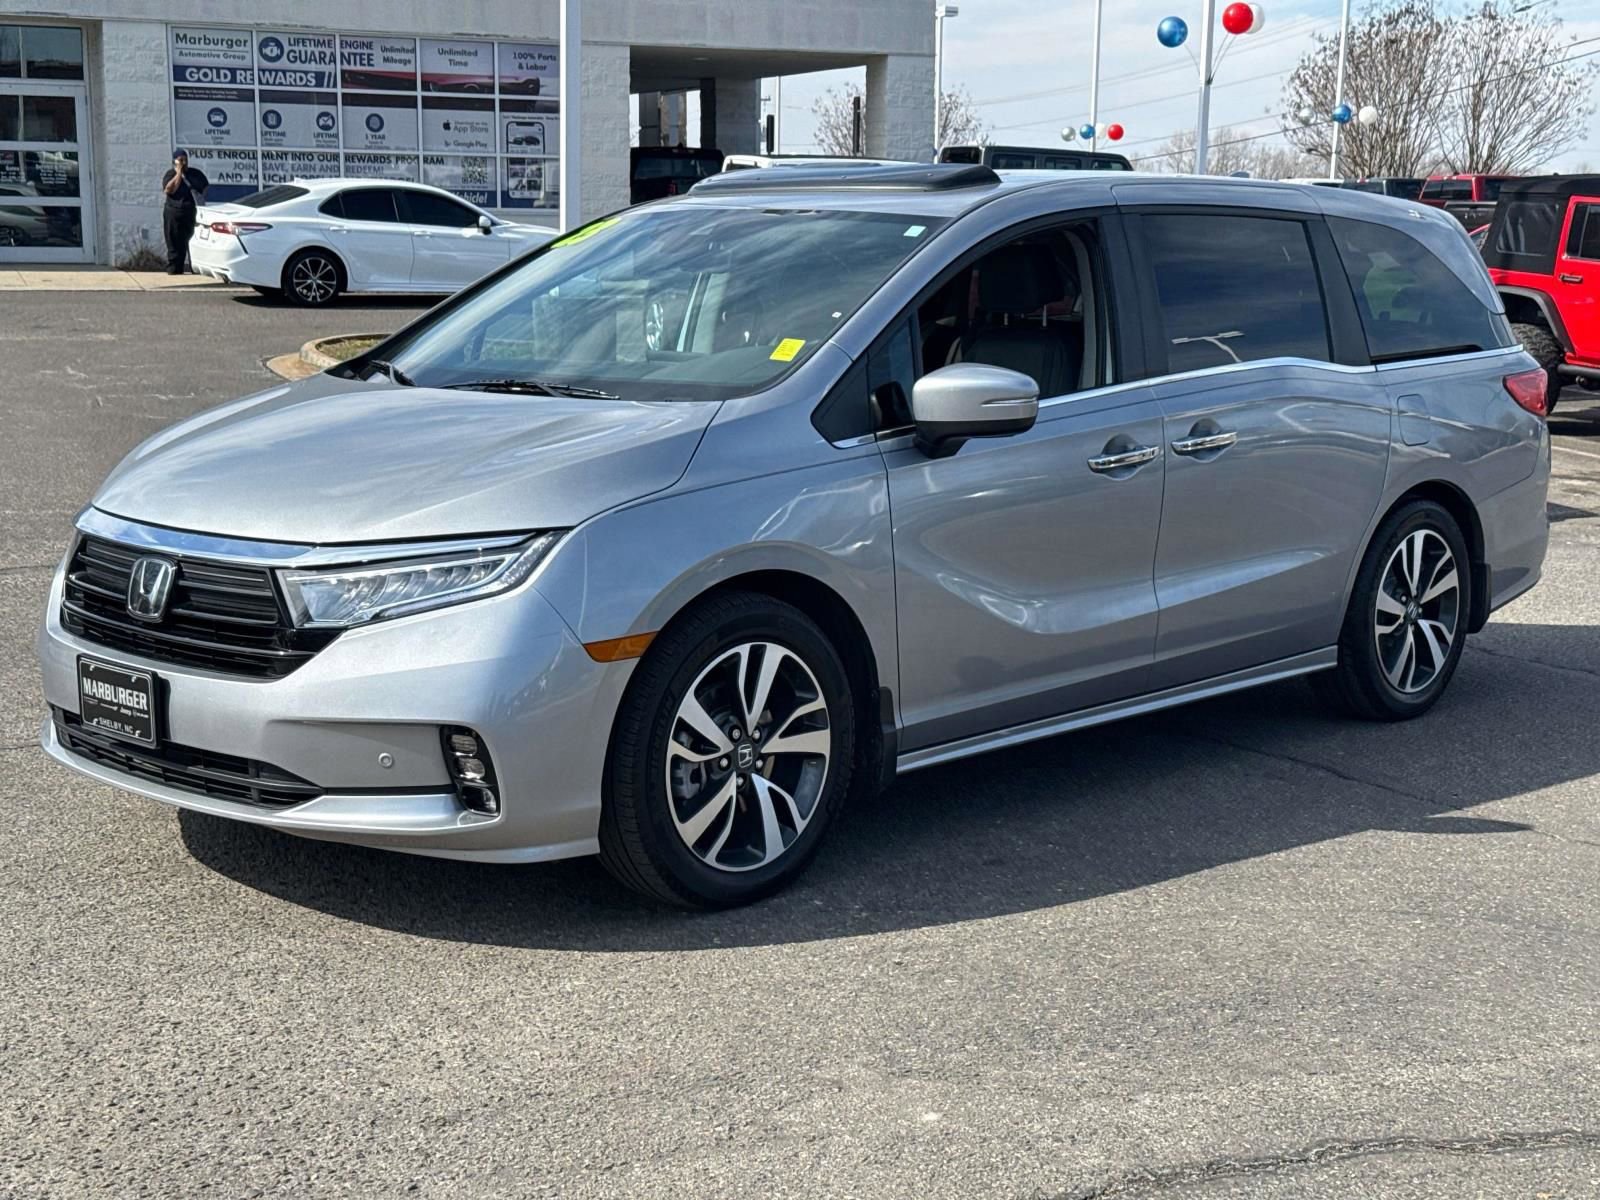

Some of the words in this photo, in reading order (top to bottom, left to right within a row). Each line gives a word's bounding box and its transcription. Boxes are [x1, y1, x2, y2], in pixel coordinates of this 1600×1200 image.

[175, 33, 248, 48] Marburger
[288, 37, 333, 48] LIFETIME
[340, 40, 374, 50] ENGINE
[380, 45, 415, 54] Unlimited
[437, 48, 478, 57] Unlimited
[178, 50, 221, 60] Automotive
[223, 52, 246, 62] Group
[286, 50, 374, 67] GUARANTEE
[382, 56, 412, 66] Mileage
[512, 52, 536, 60] 100%
[538, 52, 557, 61] Parts
[448, 58, 468, 67] Time
[526, 62, 548, 71] Labor
[186, 68, 232, 82] GOLD
[236, 70, 316, 86] REWARDS
[189, 150, 214, 159] PLUS
[218, 151, 289, 161] ENROLLMENT
[291, 152, 314, 162] INTO
[318, 152, 340, 162] OUR
[344, 154, 392, 164] REWARDS
[291, 163, 316, 172] EARN
[320, 164, 340, 173] AND
[218, 172, 244, 182] AND
[452, 191, 488, 204] hicle!
[82, 677, 148, 710] MARBURGER
